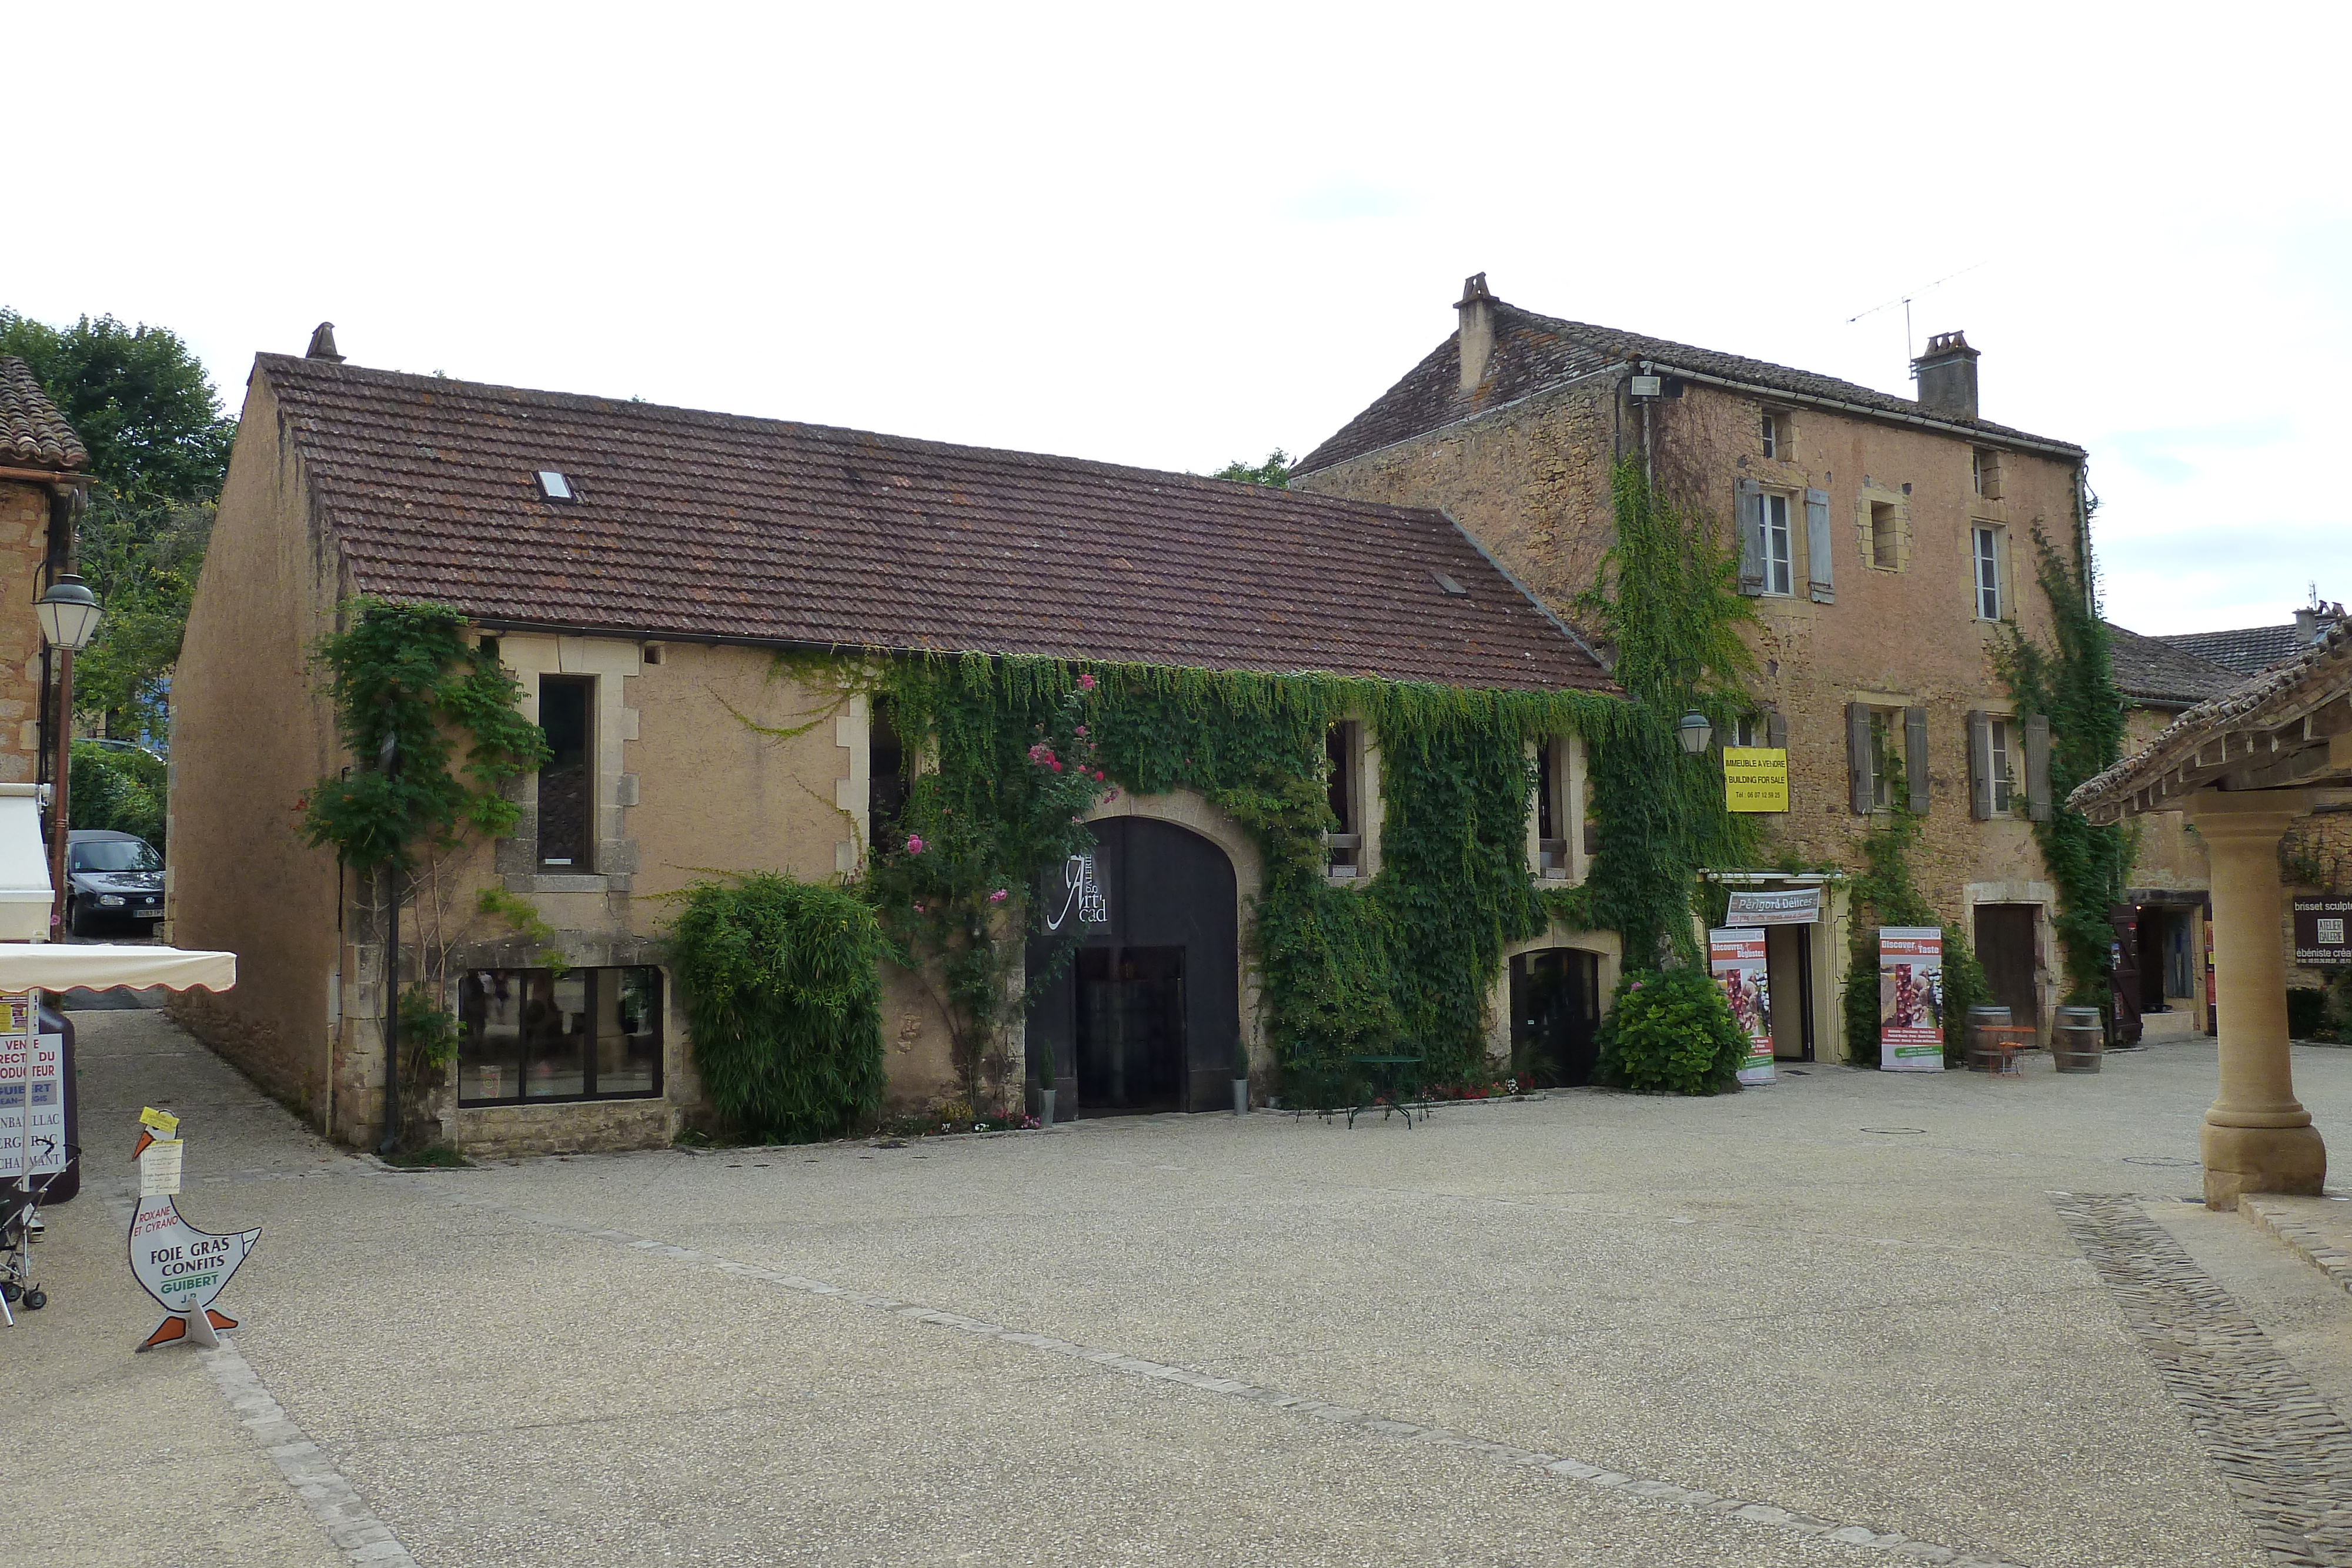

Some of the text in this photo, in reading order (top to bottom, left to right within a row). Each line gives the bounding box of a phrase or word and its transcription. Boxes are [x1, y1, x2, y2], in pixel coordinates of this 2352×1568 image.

[1739, 897, 1813, 911] Périgord Délices
[2294, 901, 2352, 912] brisset sculpt
[1882, 940, 1915, 948] Discover
[1918, 945, 1939, 954] Taste
[2296, 948, 2352, 957] ébéniste créa
[5, 1039, 39, 1051] VENE
[39, 1051, 55, 1062] DU
[0, 1065, 55, 1079] ODUTEUR
[139, 1205, 171, 1223] ROXANE
[134, 1215, 179, 1237] ET CYRANO
[151, 1237, 230, 1265] FOIE GRAS
[162, 1254, 225, 1276] CONFITS
[161, 1274, 219, 1294] GUIBERT
